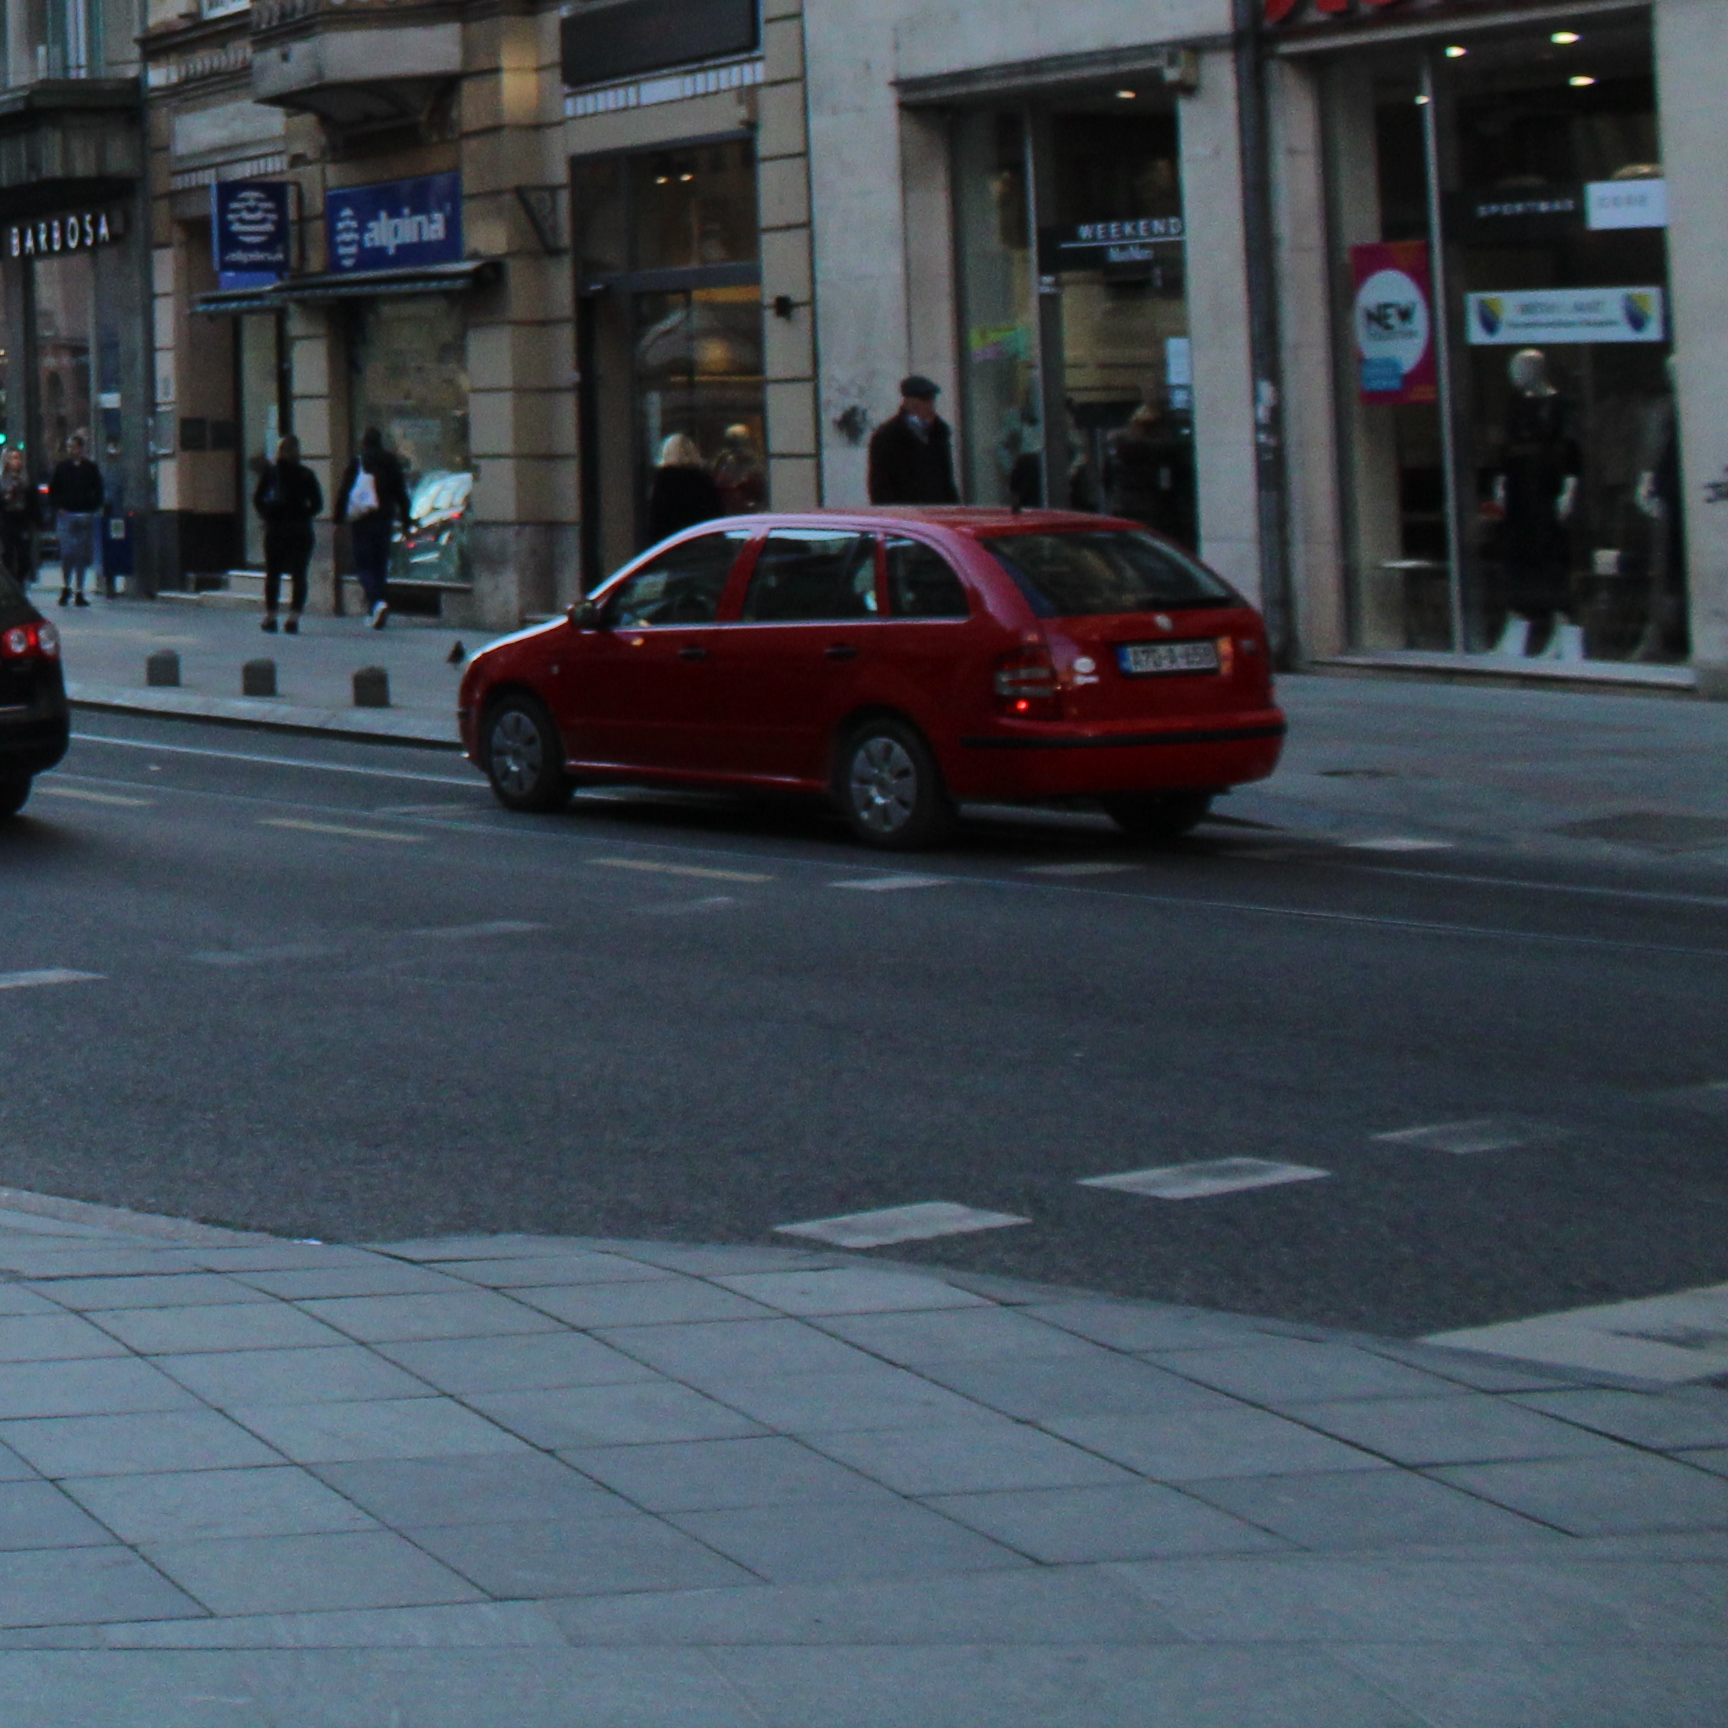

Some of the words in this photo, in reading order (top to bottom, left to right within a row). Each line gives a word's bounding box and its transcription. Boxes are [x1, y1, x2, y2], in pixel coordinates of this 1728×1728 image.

[10, 212, 110, 257] BARBOSA
[363, 206, 446, 256] alpina
[1078, 216, 1183, 240] WEEKEND
[1365, 301, 1416, 330] NEW
